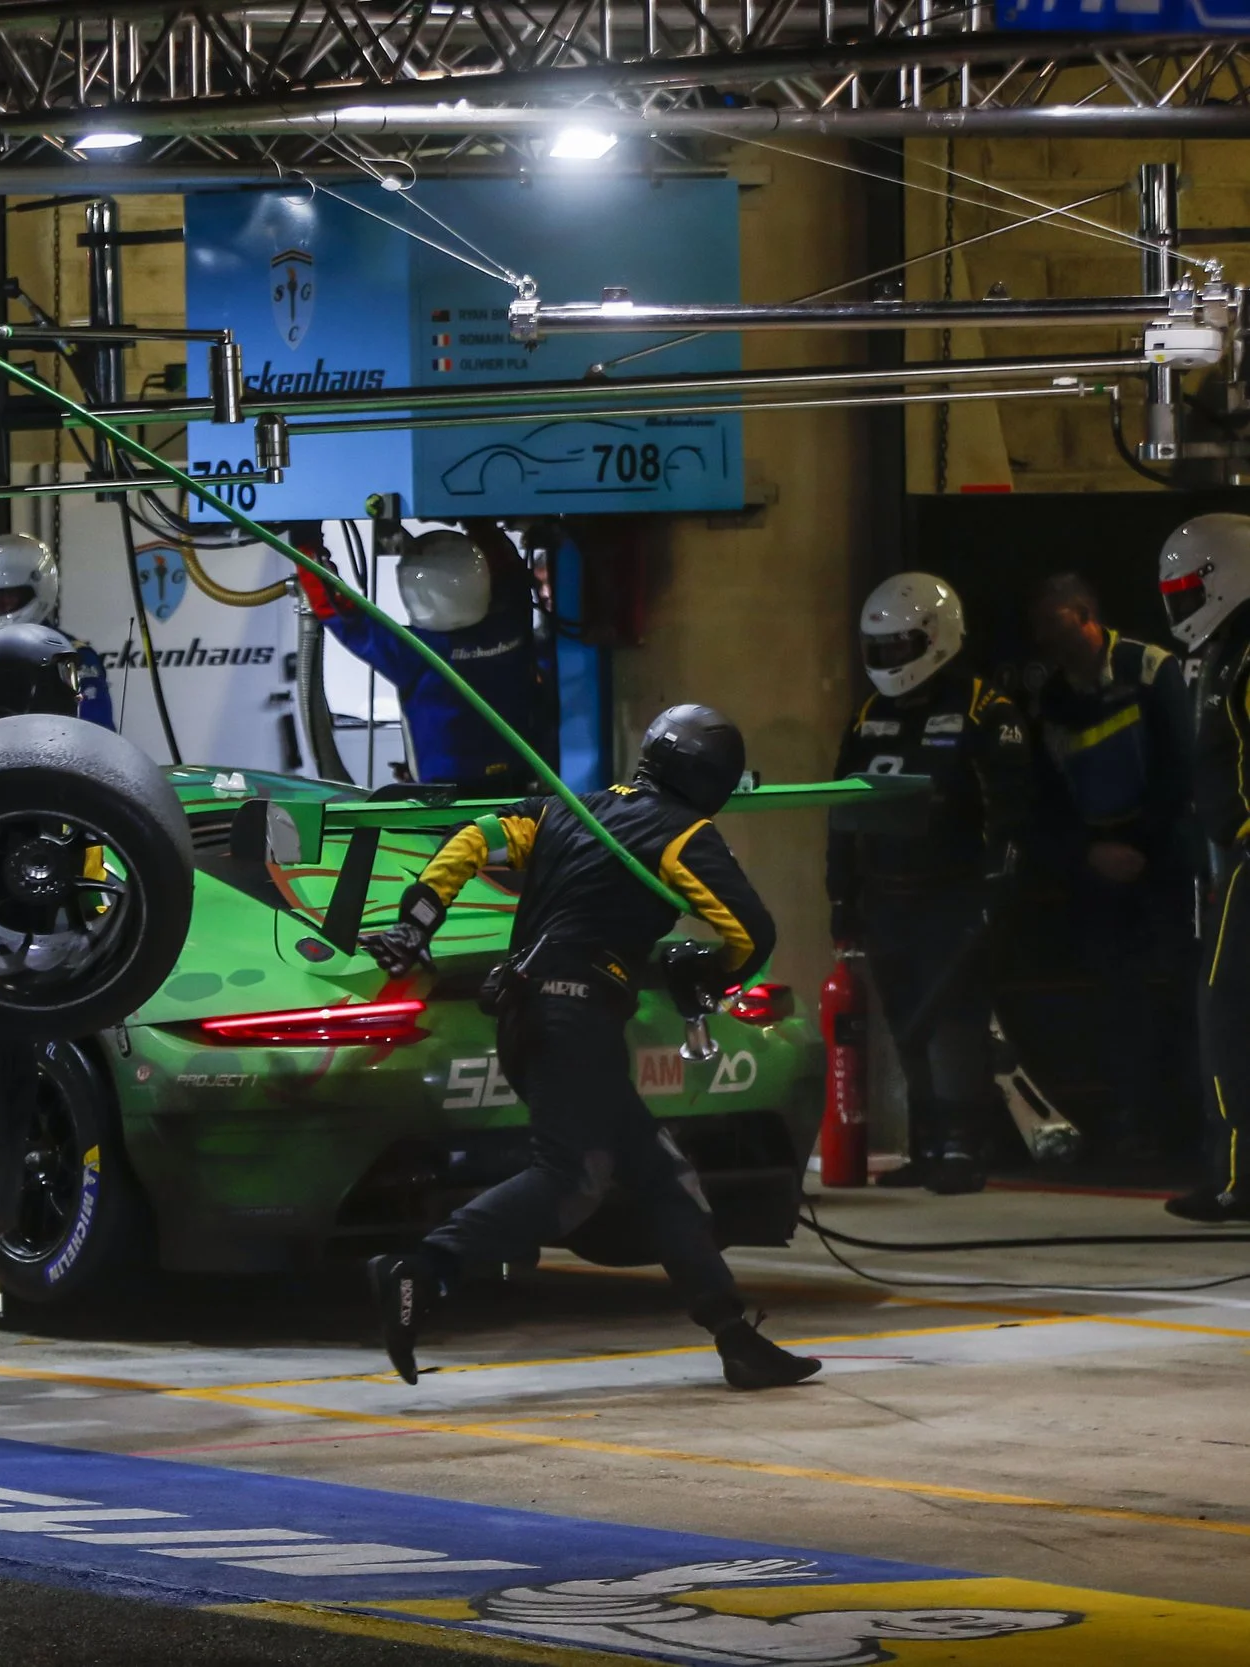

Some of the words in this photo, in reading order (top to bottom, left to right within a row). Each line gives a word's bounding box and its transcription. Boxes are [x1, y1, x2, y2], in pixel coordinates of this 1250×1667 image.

[244, 358, 385, 393] ckenhaus
[593, 443, 661, 484] 708
[539, 980, 590, 999] MRTC
[177, 1074, 249, 1087] PROJECT
[250, 1074, 259, 1087] 1
[640, 1054, 682, 1088] AM
[49, 1191, 95, 1281] MICHELIN
